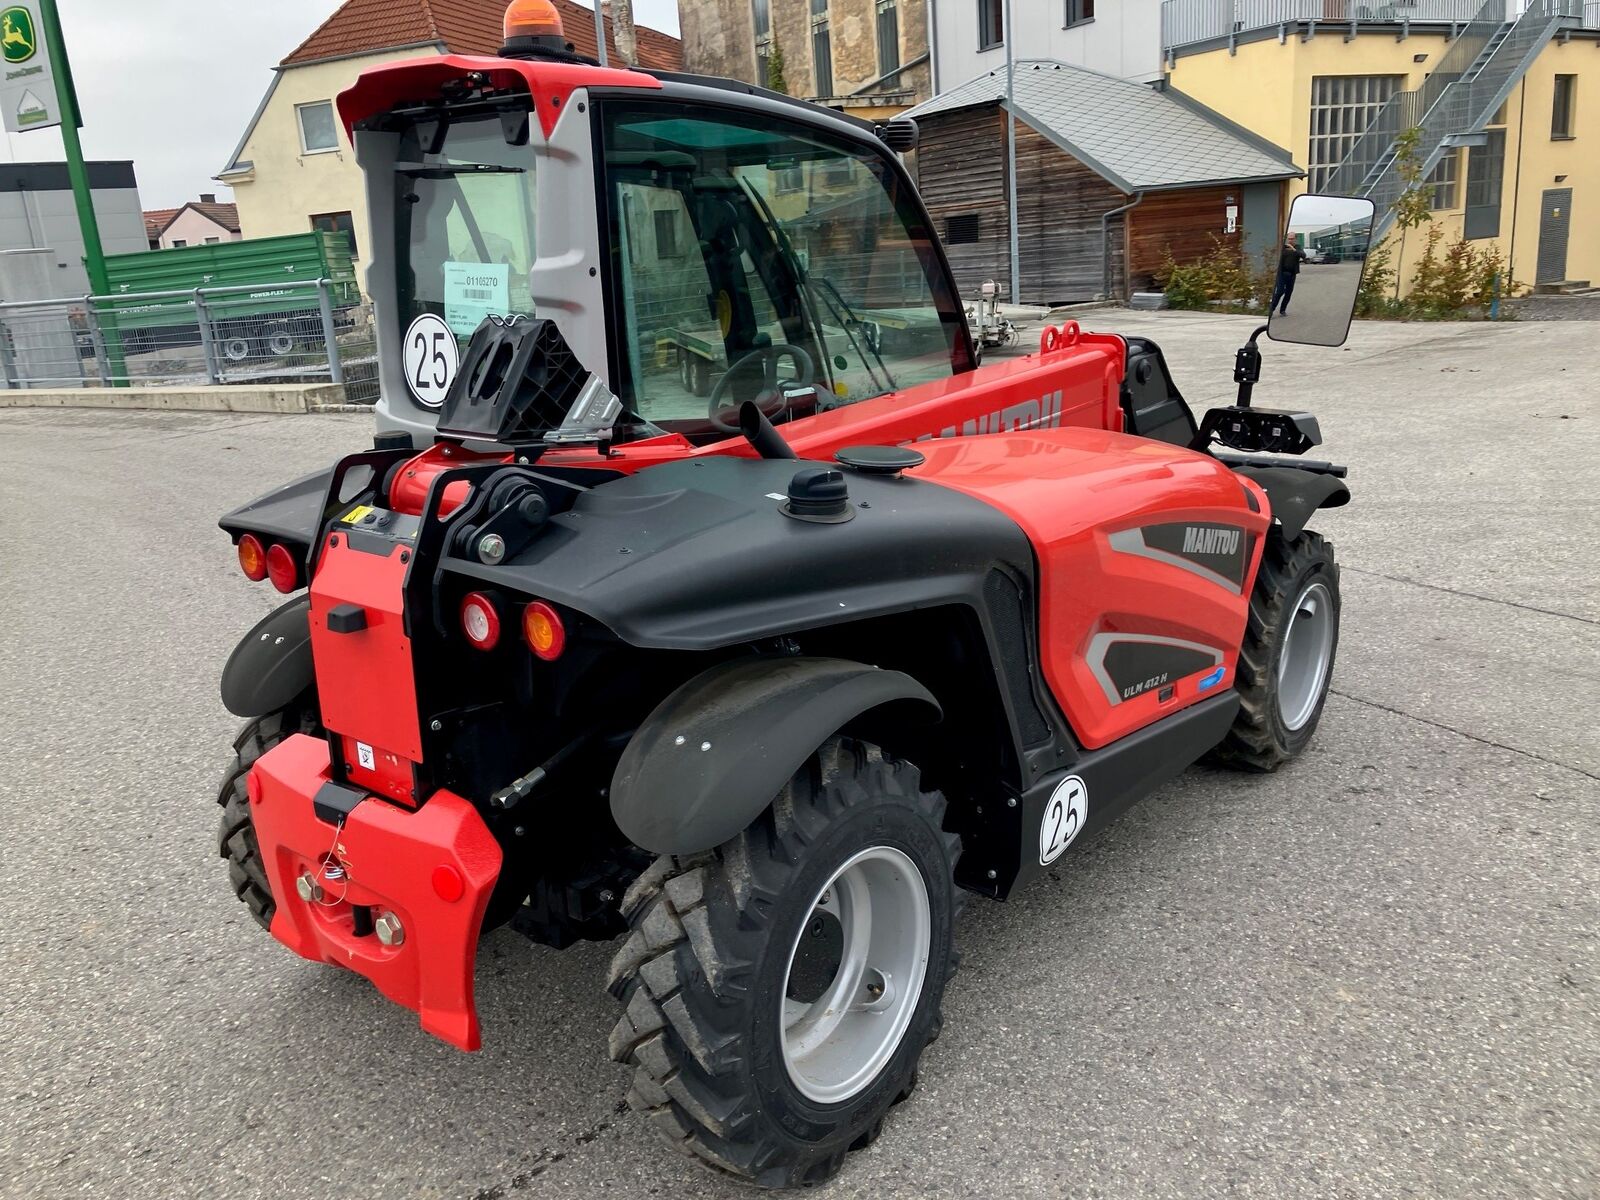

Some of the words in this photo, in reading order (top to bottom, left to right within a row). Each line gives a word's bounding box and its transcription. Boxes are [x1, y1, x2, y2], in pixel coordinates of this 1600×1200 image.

[414, 332, 448, 389] 25
[1182, 527, 1240, 555] MANITOU
[1124, 682, 1144, 698] ULM
[1144, 676, 1160, 690] 412
[1160, 672, 1168, 684] H
[1045, 788, 1079, 857] 25
